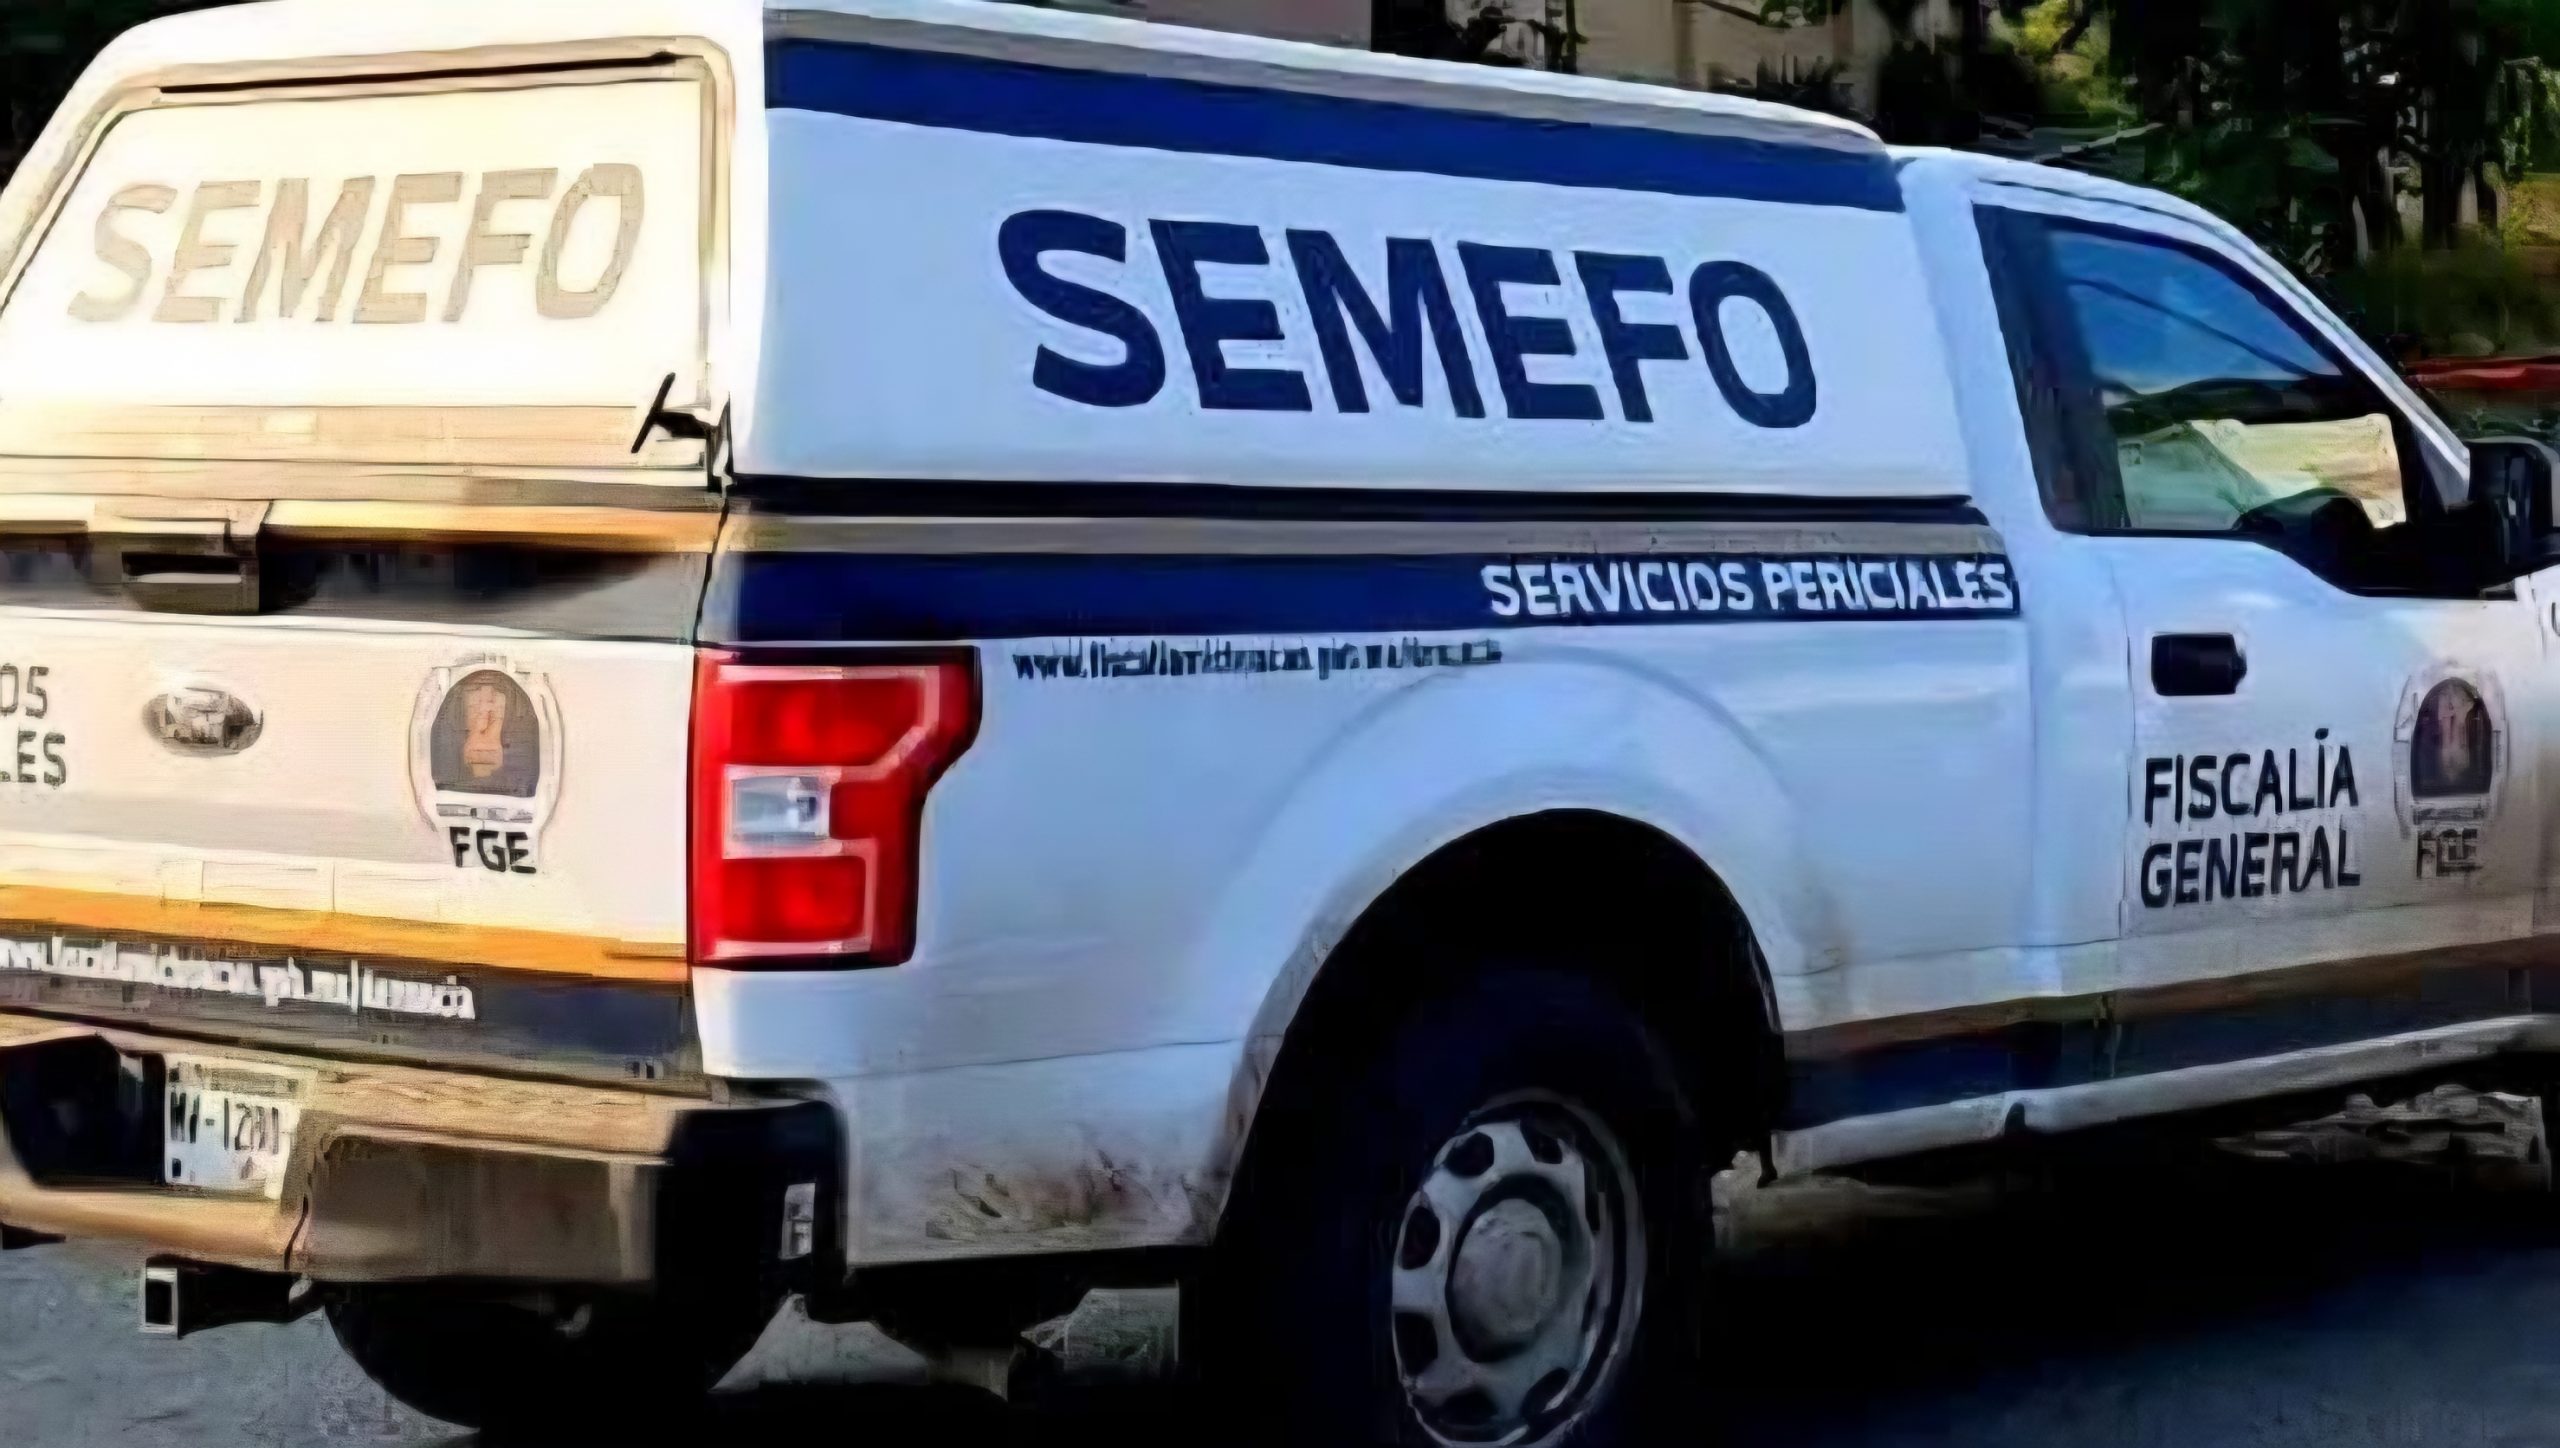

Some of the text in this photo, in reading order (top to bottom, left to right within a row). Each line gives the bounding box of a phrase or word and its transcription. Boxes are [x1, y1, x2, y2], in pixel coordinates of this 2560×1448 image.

[67, 163, 645, 324] SEMEFO
[999, 209, 1818, 429] SEMEFO
[1481, 558, 2015, 616] SERVICIOS PERICIALES
[2144, 728, 2359, 827] FISCALÍA
[450, 826, 537, 874] FGE
[2140, 825, 2361, 908] GENERAL
